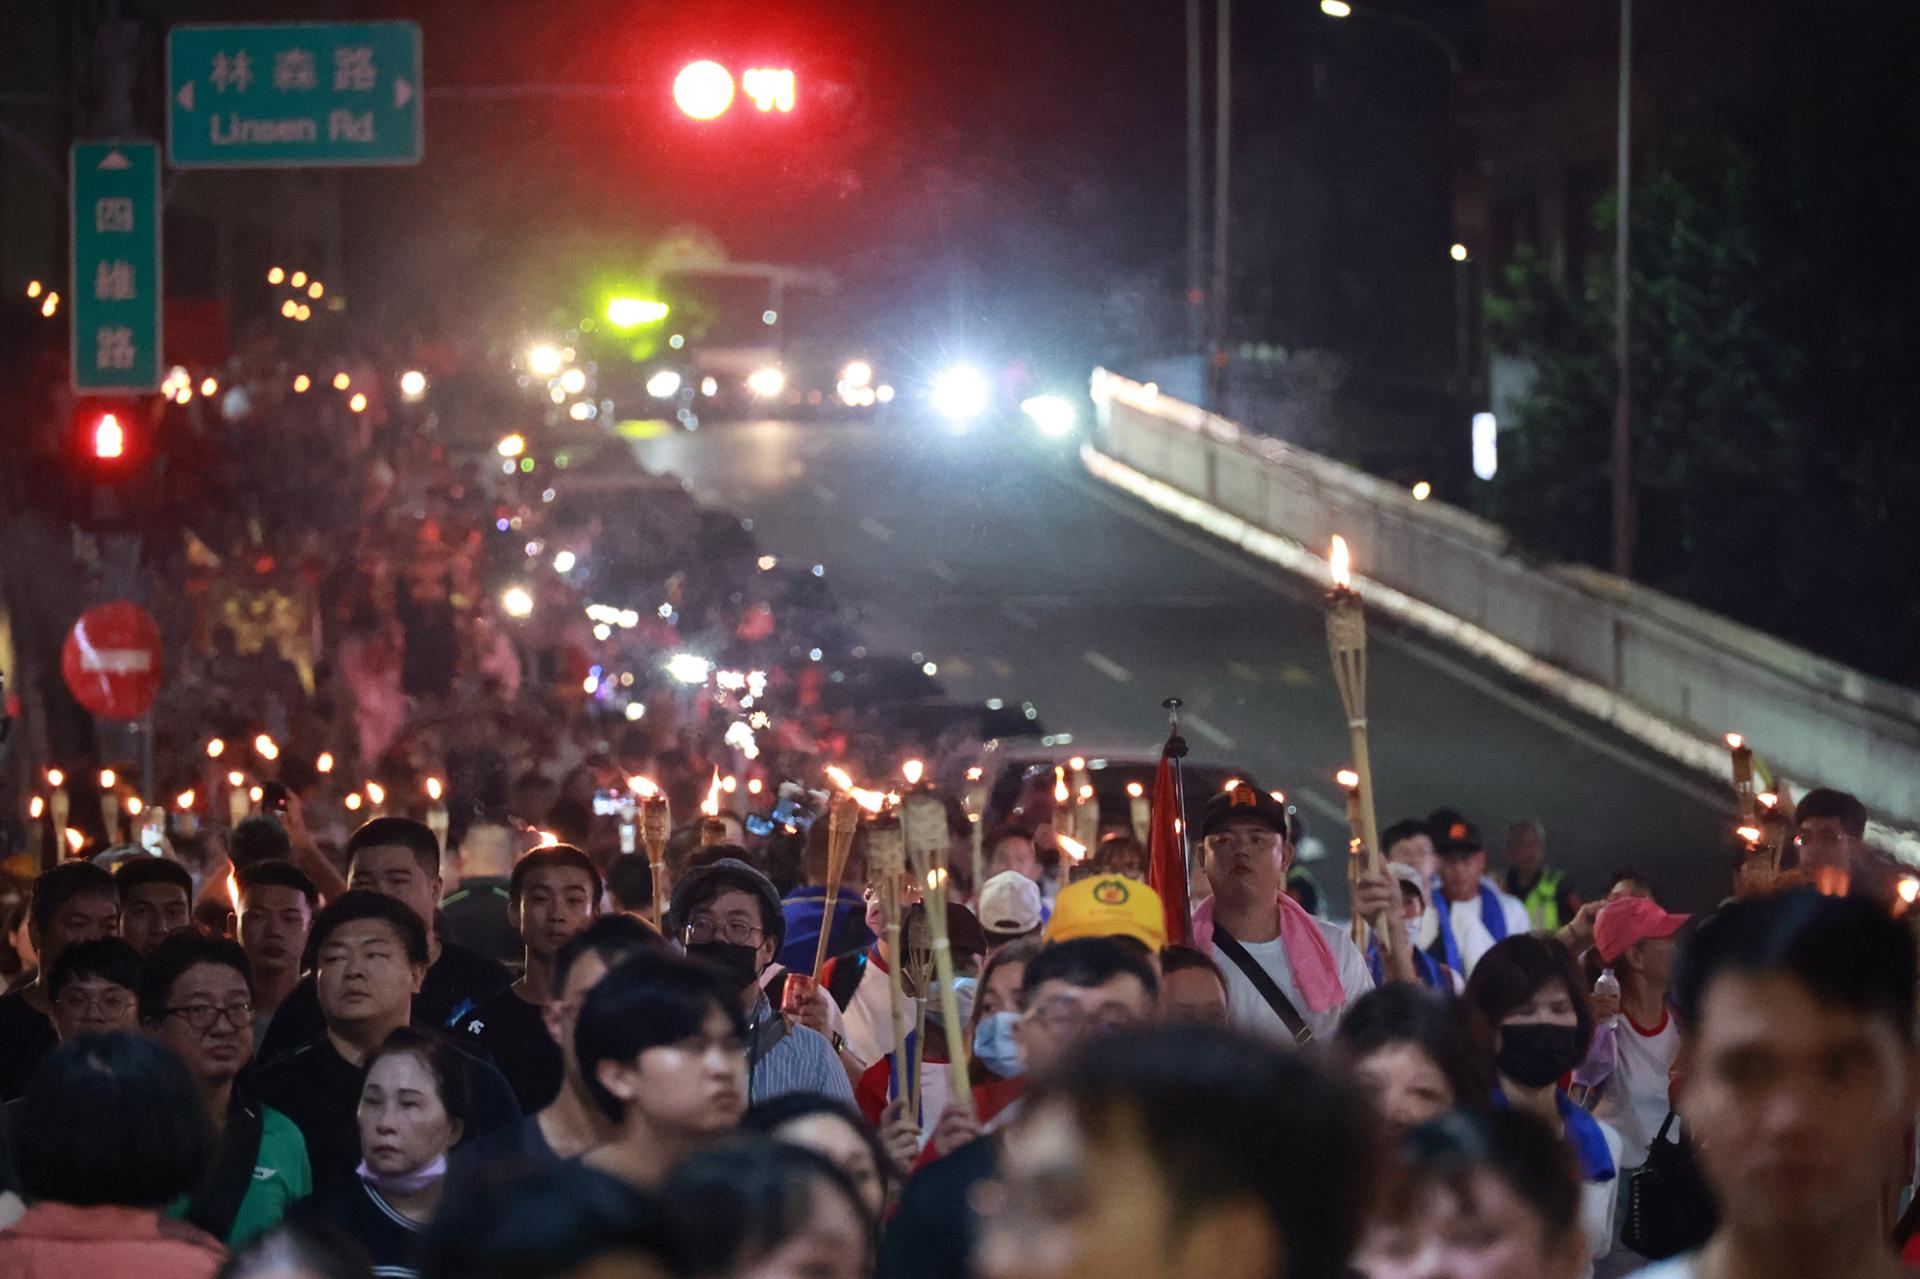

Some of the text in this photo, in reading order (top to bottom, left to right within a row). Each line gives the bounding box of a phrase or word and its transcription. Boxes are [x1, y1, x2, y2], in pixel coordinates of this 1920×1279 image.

[209, 48, 376, 94] 林森路
[209, 108, 375, 145] Linsen Rd
[95, 197, 136, 370] 四維路
